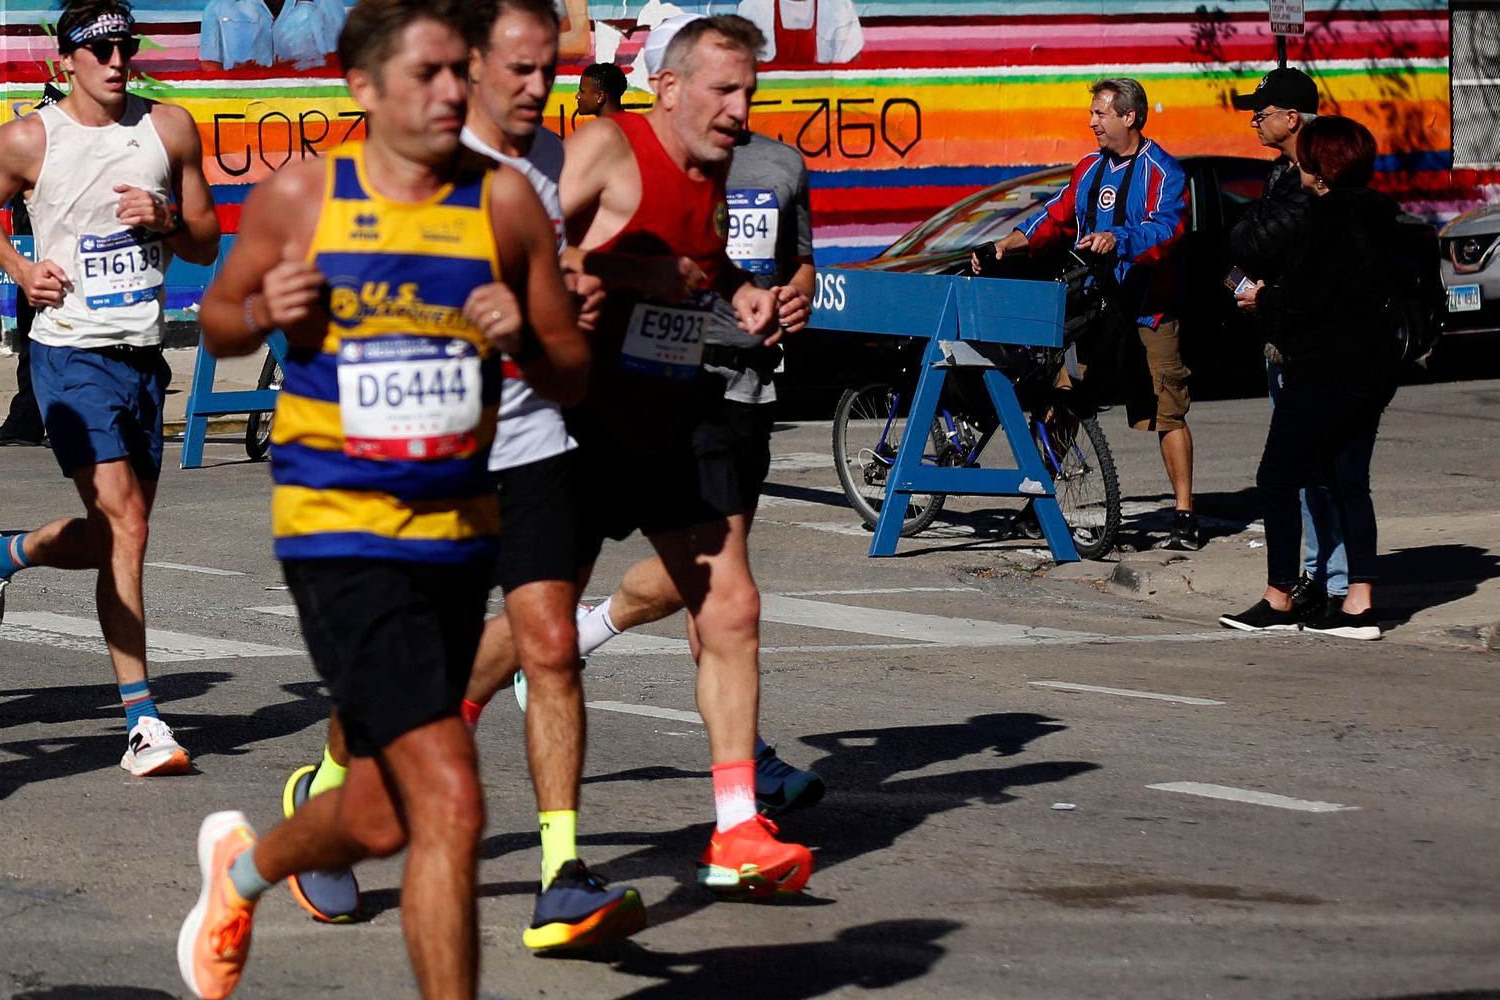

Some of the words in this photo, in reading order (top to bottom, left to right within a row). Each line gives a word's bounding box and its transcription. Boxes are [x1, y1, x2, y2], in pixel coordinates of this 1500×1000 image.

[84, 246, 160, 278] E16139
[812, 273, 847, 311] OSS
[358, 365, 468, 409] D6444
